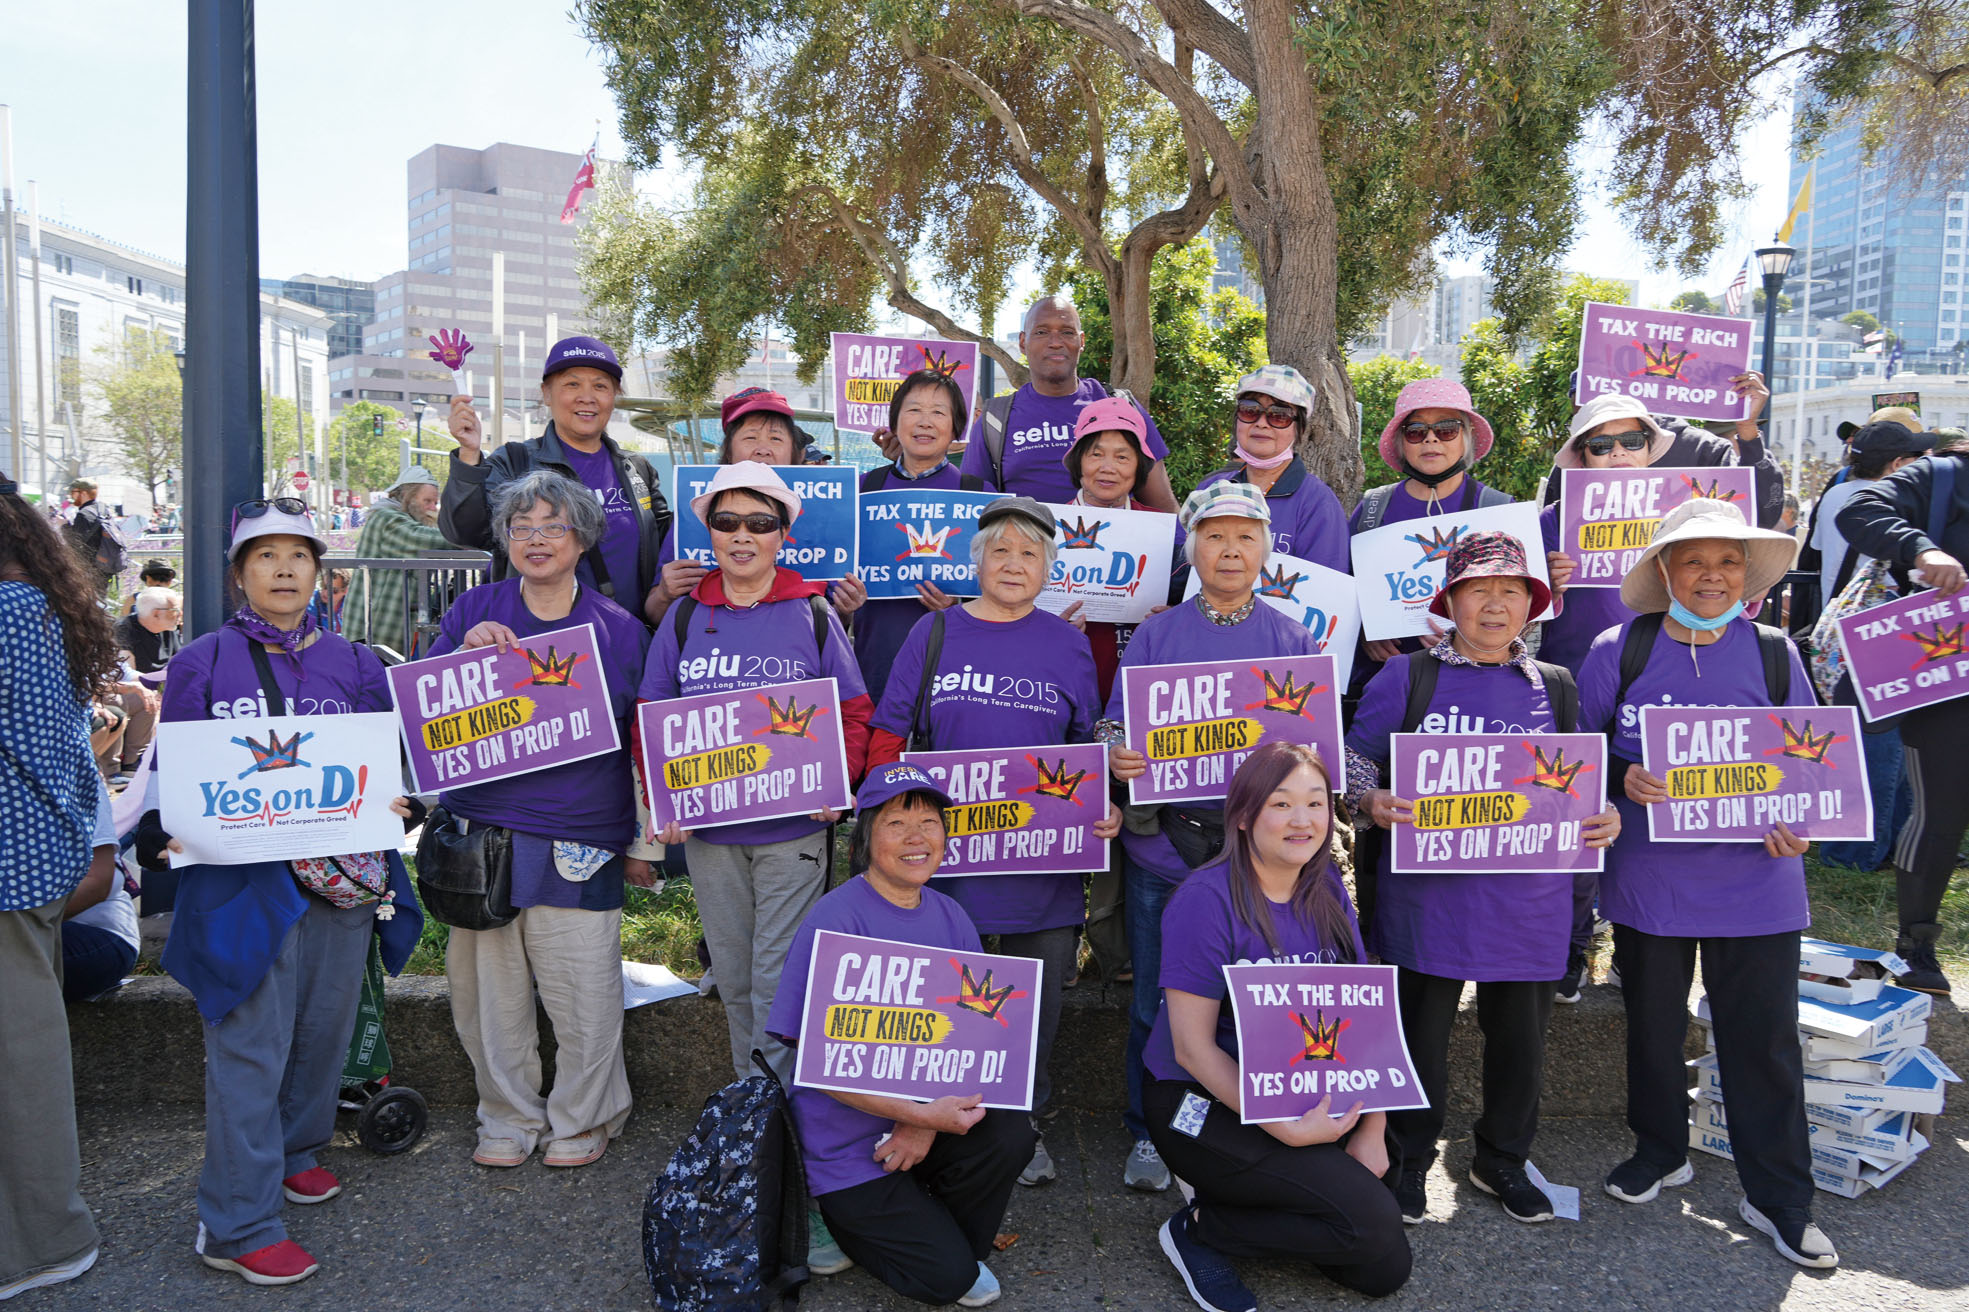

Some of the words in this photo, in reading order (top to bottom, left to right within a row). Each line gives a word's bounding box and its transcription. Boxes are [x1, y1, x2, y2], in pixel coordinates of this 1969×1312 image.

[1598, 318, 1638, 336] TAX
[1645, 323, 1685, 342] THE
[563, 346, 587, 357] seiu
[847, 344, 904, 379] CARE
[848, 380, 870, 401] NOT
[1586, 375, 1622, 395] YES
[1628, 381, 1659, 399] ON
[1666, 385, 1718, 405] PROP
[1724, 390, 1739, 406] D
[846, 403, 870, 425] YES
[871, 404, 891, 427] ON
[1012, 421, 1070, 446] seiu
[866, 504, 901, 521] TAX
[907, 503, 946, 519] THE
[1363, 492, 1381, 528] dream
[1582, 477, 1664, 521] CARE
[1584, 524, 1617, 549] NOT
[775, 548, 827, 565] PROP
[834, 548, 848, 564] D
[858, 565, 891, 582] YES
[897, 564, 923, 581] ON
[1072, 565, 1104, 584] on
[1105, 551, 1147, 587] D!
[1580, 551, 1616, 579] YES
[1385, 571, 1434, 601] Yes
[1854, 615, 1903, 641] TAX
[1904, 600, 1954, 625] THE
[679, 648, 741, 683] seiu
[744, 655, 806, 681] 2015
[1866, 677, 1911, 701] YES
[1915, 665, 1952, 688] ON
[416, 655, 504, 719] CARE
[737, 680, 758, 688] Term
[931, 665, 994, 697] seiu
[997, 676, 1059, 704] 2015
[1148, 671, 1234, 726] CARE
[967, 695, 988, 705] Long
[991, 698, 1011, 708] Term
[1013, 701, 1057, 716] Caregivers
[1415, 705, 1485, 734] eiu
[428, 715, 463, 750] NOT
[468, 698, 522, 738] KINGS
[663, 700, 743, 758] CARE
[1153, 727, 1191, 758] NOT
[1194, 719, 1248, 752] KINGS
[1667, 717, 1752, 765] CARE
[431, 746, 472, 782] YES
[475, 734, 506, 770] ON
[510, 716, 564, 759] PROP
[569, 708, 592, 741] D!
[669, 756, 701, 789] NOT
[708, 745, 757, 779] KINGS
[1150, 759, 1189, 793] YES
[1195, 755, 1225, 786] ON
[1415, 744, 1505, 795] CARE
[1671, 769, 1707, 797] NOT
[1714, 763, 1767, 794] KINGS
[200, 781, 262, 817] Yes
[272, 788, 315, 811] on
[318, 764, 368, 808] D!
[670, 787, 705, 821] YES
[710, 779, 738, 813] ON
[744, 767, 796, 806] PROP
[802, 762, 823, 794] D!
[290, 817, 326, 826] Corporate
[967, 802, 1019, 832] KINGS
[1418, 798, 1455, 827] NOT
[1460, 793, 1515, 825] KINGS
[1670, 799, 1709, 831] YES
[1716, 796, 1748, 829] ON
[1753, 792, 1812, 826] PROP
[1819, 789, 1843, 820] D!
[967, 834, 996, 863] ON
[1003, 830, 1057, 860] PROP
[1063, 825, 1085, 856] D!
[1415, 830, 1454, 863] YES
[1459, 828, 1490, 860] ON
[1496, 823, 1552, 857] PROP
[1557, 820, 1580, 852] D!
[832, 952, 931, 1006] CARE
[1246, 984, 1292, 1006] TAX
[1298, 983, 1335, 1006] THE
[829, 1007, 872, 1039] NOT
[875, 1010, 936, 1043] KINGS
[823, 1042, 866, 1079] YES
[871, 1045, 907, 1080] ON
[911, 1047, 975, 1083] PROP
[979, 1050, 1007, 1084] D!
[1249, 1072, 1284, 1097] YES
[1290, 1070, 1318, 1094] ON
[1325, 1068, 1381, 1093] PROP
[1390, 1067, 1406, 1088] D
[1845, 1093, 1885, 1103] Domino's
